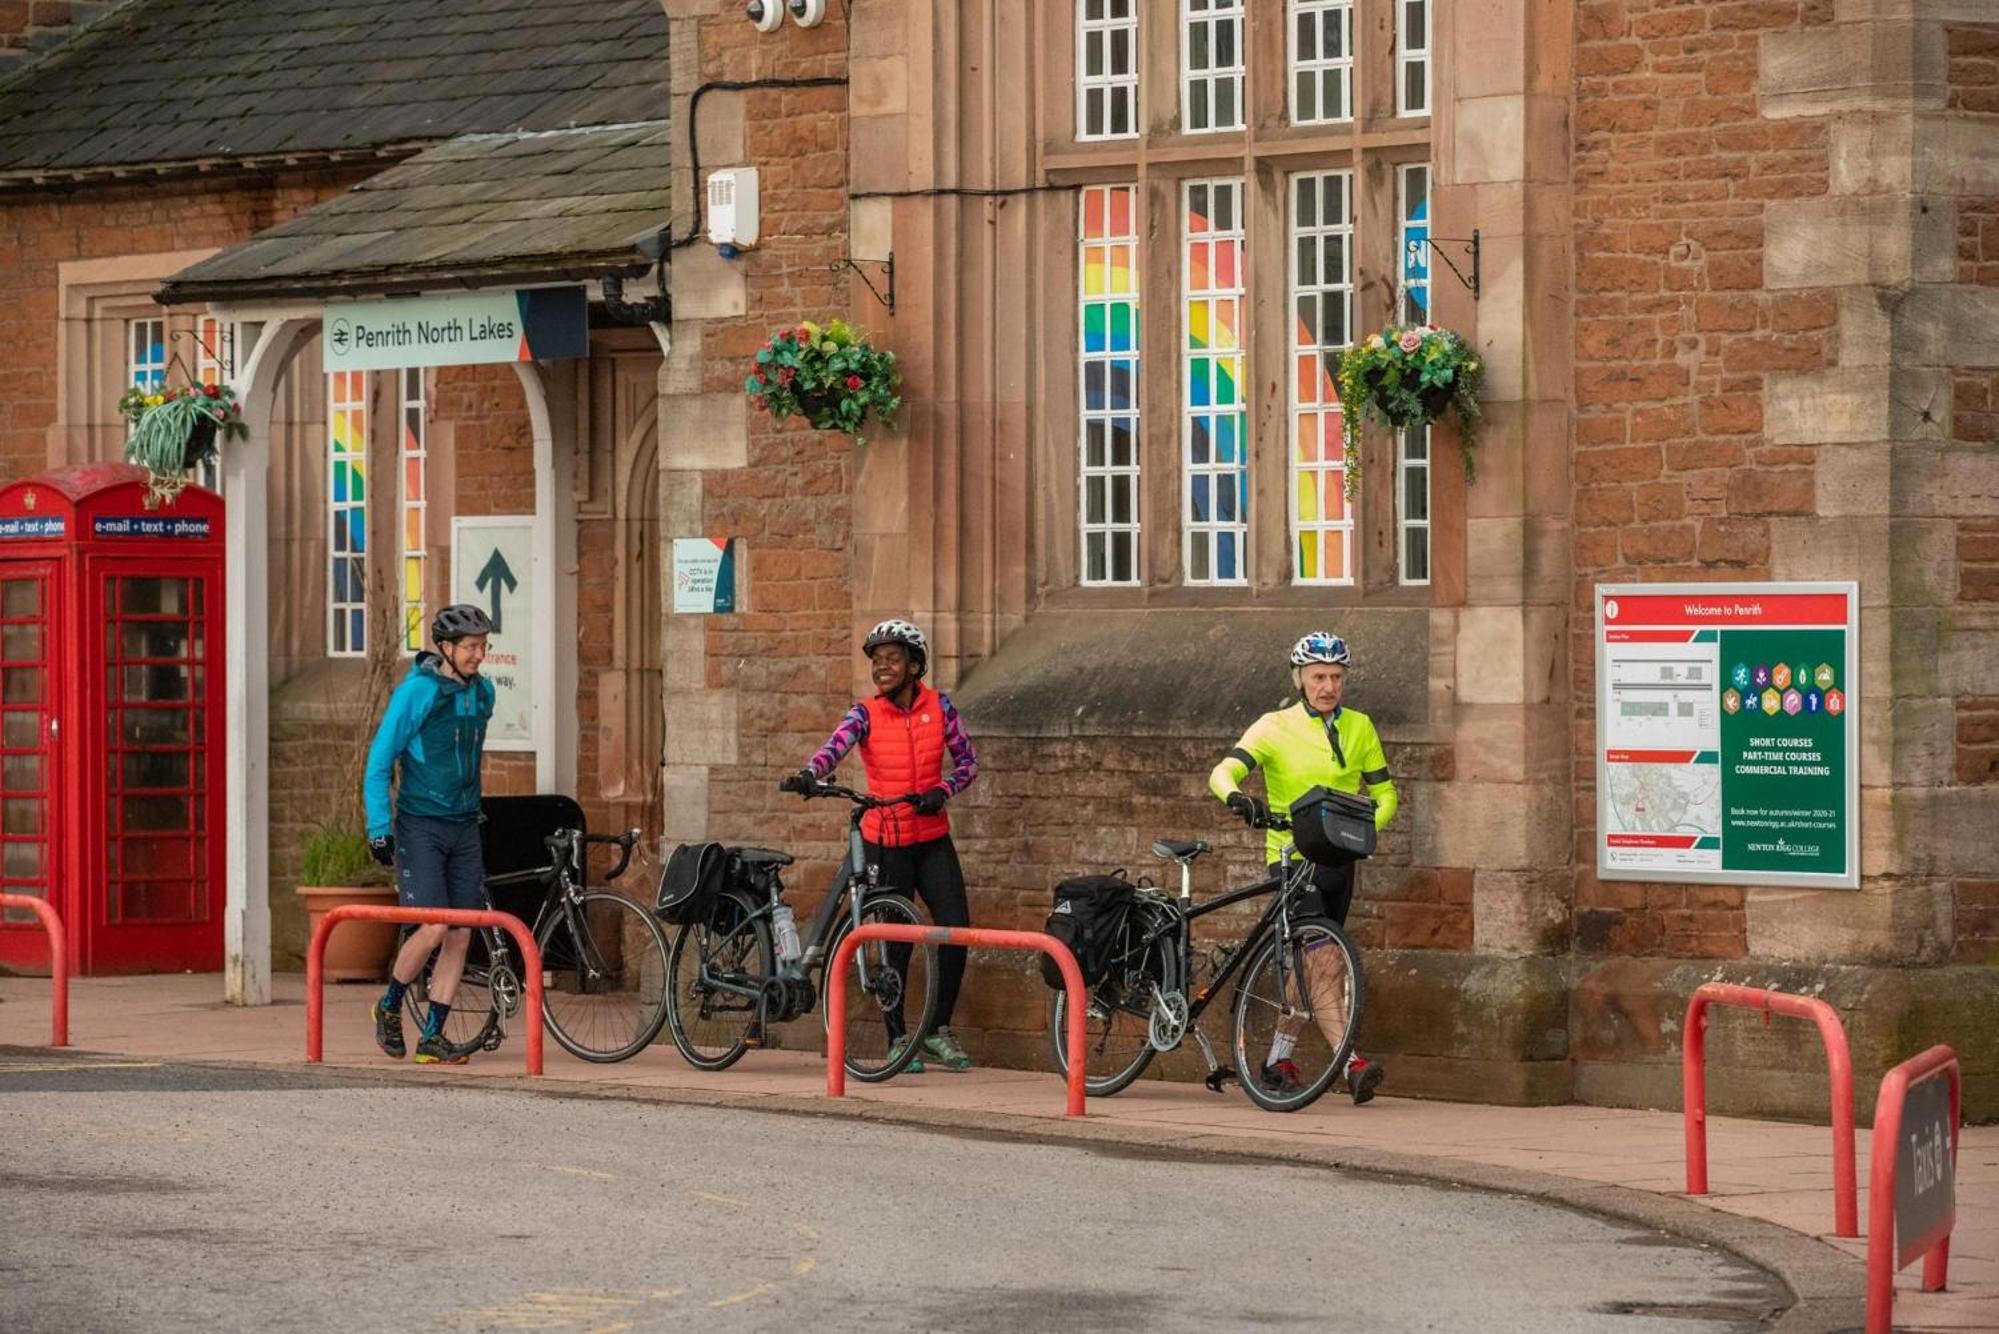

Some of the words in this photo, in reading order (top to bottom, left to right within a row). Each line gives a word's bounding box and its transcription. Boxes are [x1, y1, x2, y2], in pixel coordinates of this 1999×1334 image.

[356, 322, 412, 348] Penrith
[417, 318, 463, 344] North
[469, 315, 513, 341] Lakes
[95, 520, 130, 532] e-mail
[141, 521, 164, 532] text
[174, 518, 209, 535] phone
[1684, 603, 1722, 615] Welcome
[1724, 605, 1732, 616] to
[1734, 603, 1762, 616] Penrith
[1749, 737, 1775, 747] SHORT
[1776, 738, 1813, 747] COURSES
[1742, 751, 1783, 760] PART-TIME
[1785, 752, 1821, 761] COURSES
[1735, 765, 1787, 775] COMMERCIAL
[1788, 766, 1830, 775] TRAINING
[1730, 807, 1745, 815] Book
[1748, 843, 1775, 851] NEWTON
[1911, 1123, 1934, 1197] Taxis
